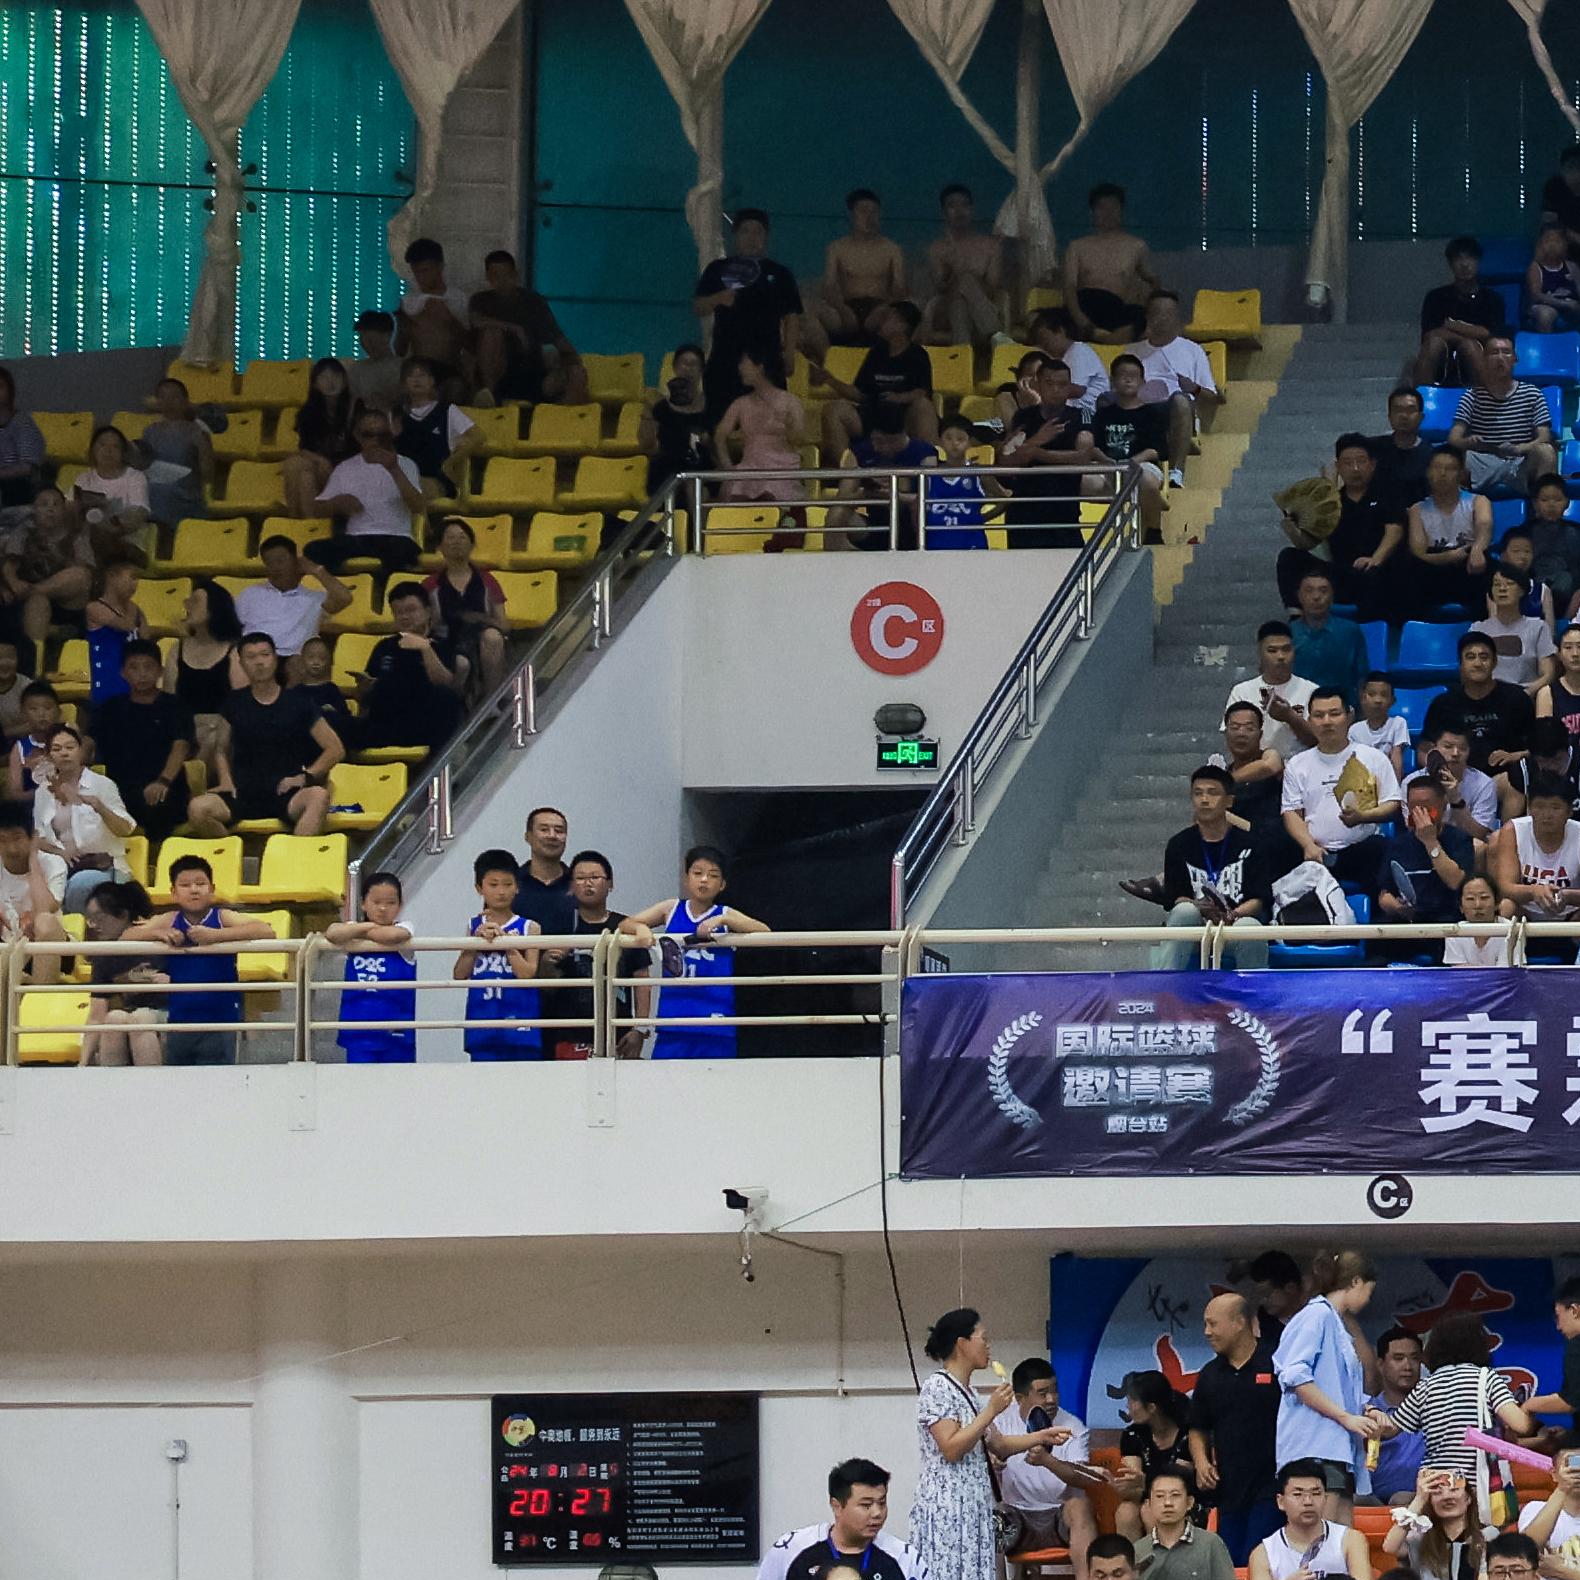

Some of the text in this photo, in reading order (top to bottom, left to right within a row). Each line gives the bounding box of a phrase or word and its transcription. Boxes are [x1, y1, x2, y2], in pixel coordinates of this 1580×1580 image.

[1117, 1001, 1155, 1015] 2024
[1055, 1023, 1216, 1058] 国际篮球
[1062, 1064, 1214, 1107] 邀请赛
